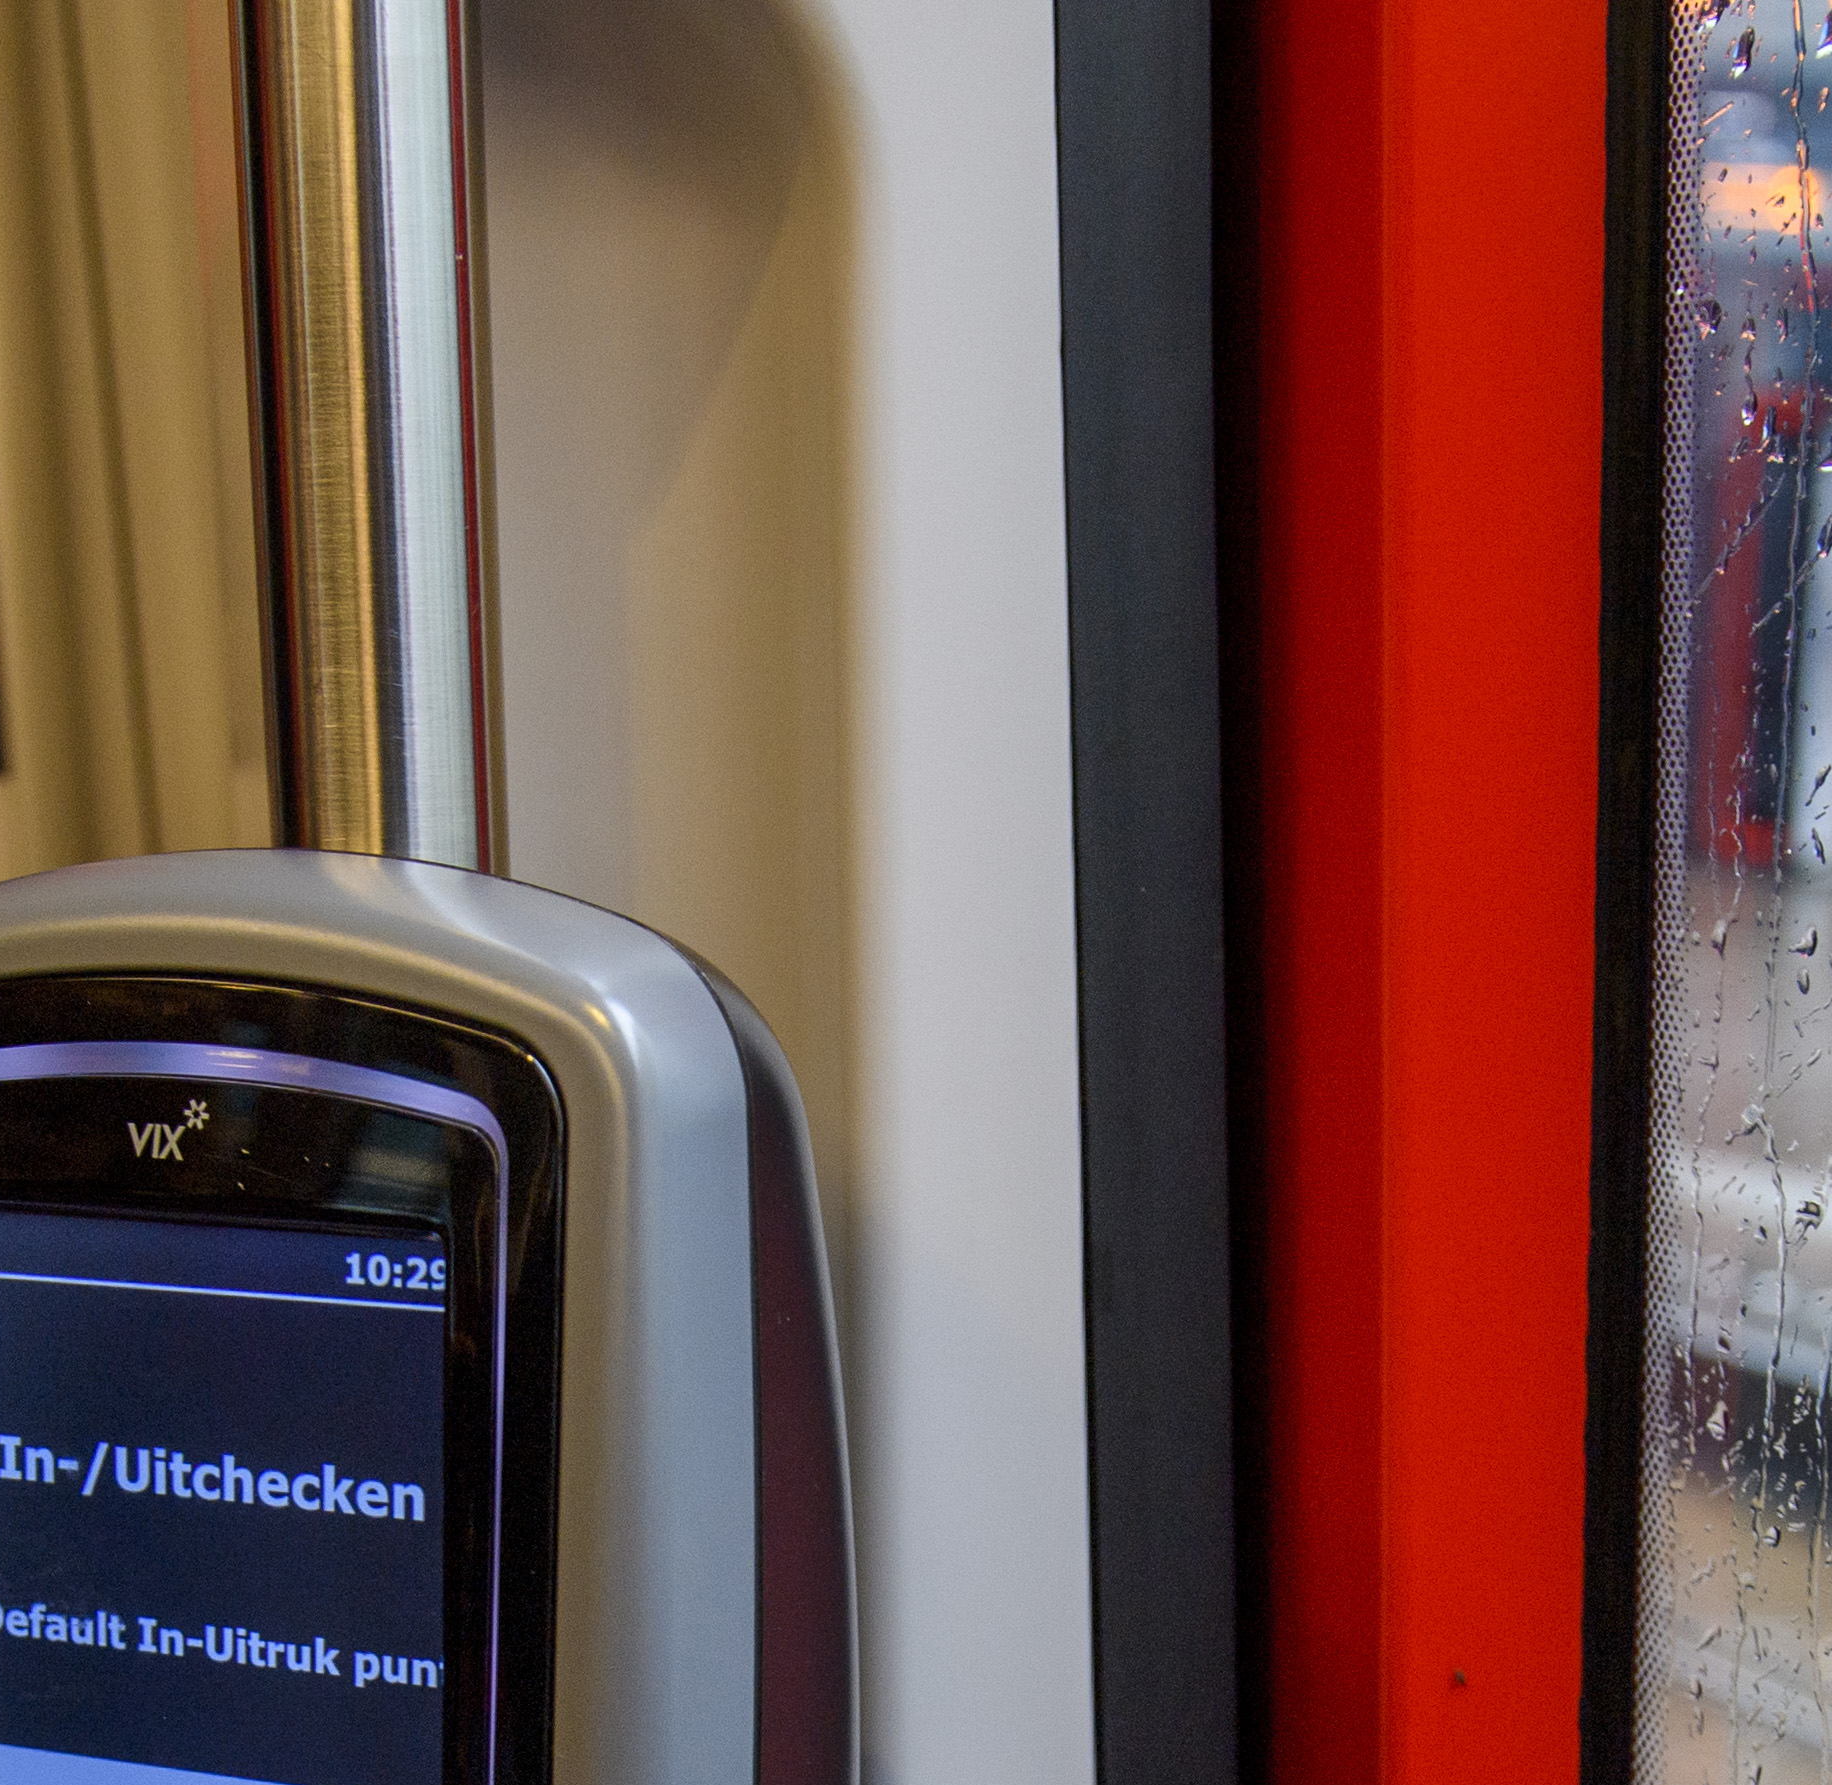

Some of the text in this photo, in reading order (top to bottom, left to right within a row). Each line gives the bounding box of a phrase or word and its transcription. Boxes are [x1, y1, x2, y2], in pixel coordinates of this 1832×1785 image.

[345, 1252, 446, 1292] 10:29
[136, 1616, 341, 1677] In-Uitruk
[352, 1651, 445, 1688] pun
